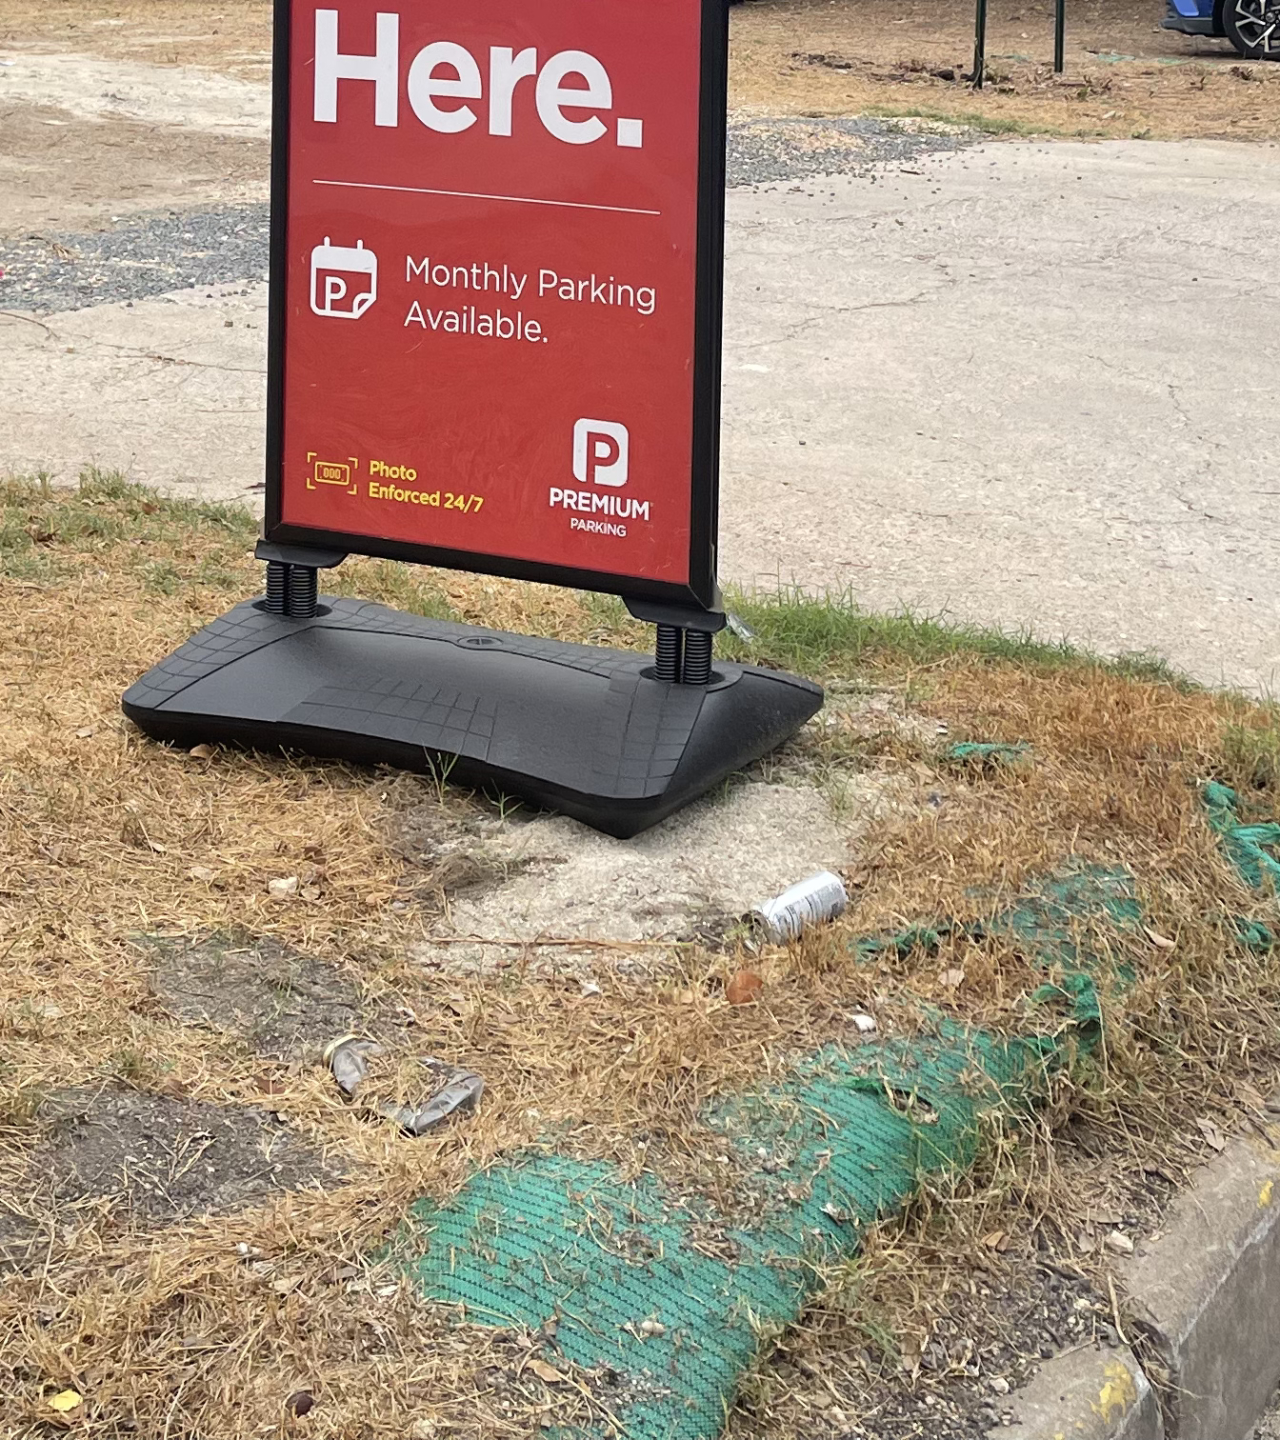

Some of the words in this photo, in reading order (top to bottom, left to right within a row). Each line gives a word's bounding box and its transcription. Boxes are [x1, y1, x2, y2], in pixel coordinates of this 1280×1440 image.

[313, 8, 644, 149] Here.
[406, 255, 527, 300] Monthly
[538, 268, 656, 315] Parking
[404, 300, 549, 343] Available.
[369, 460, 417, 481] Photo
[369, 482, 440, 507] Enforced
[443, 492, 484, 513] 24/7
[549, 487, 650, 521] PREMIUM
[570, 518, 627, 537] PARKING
